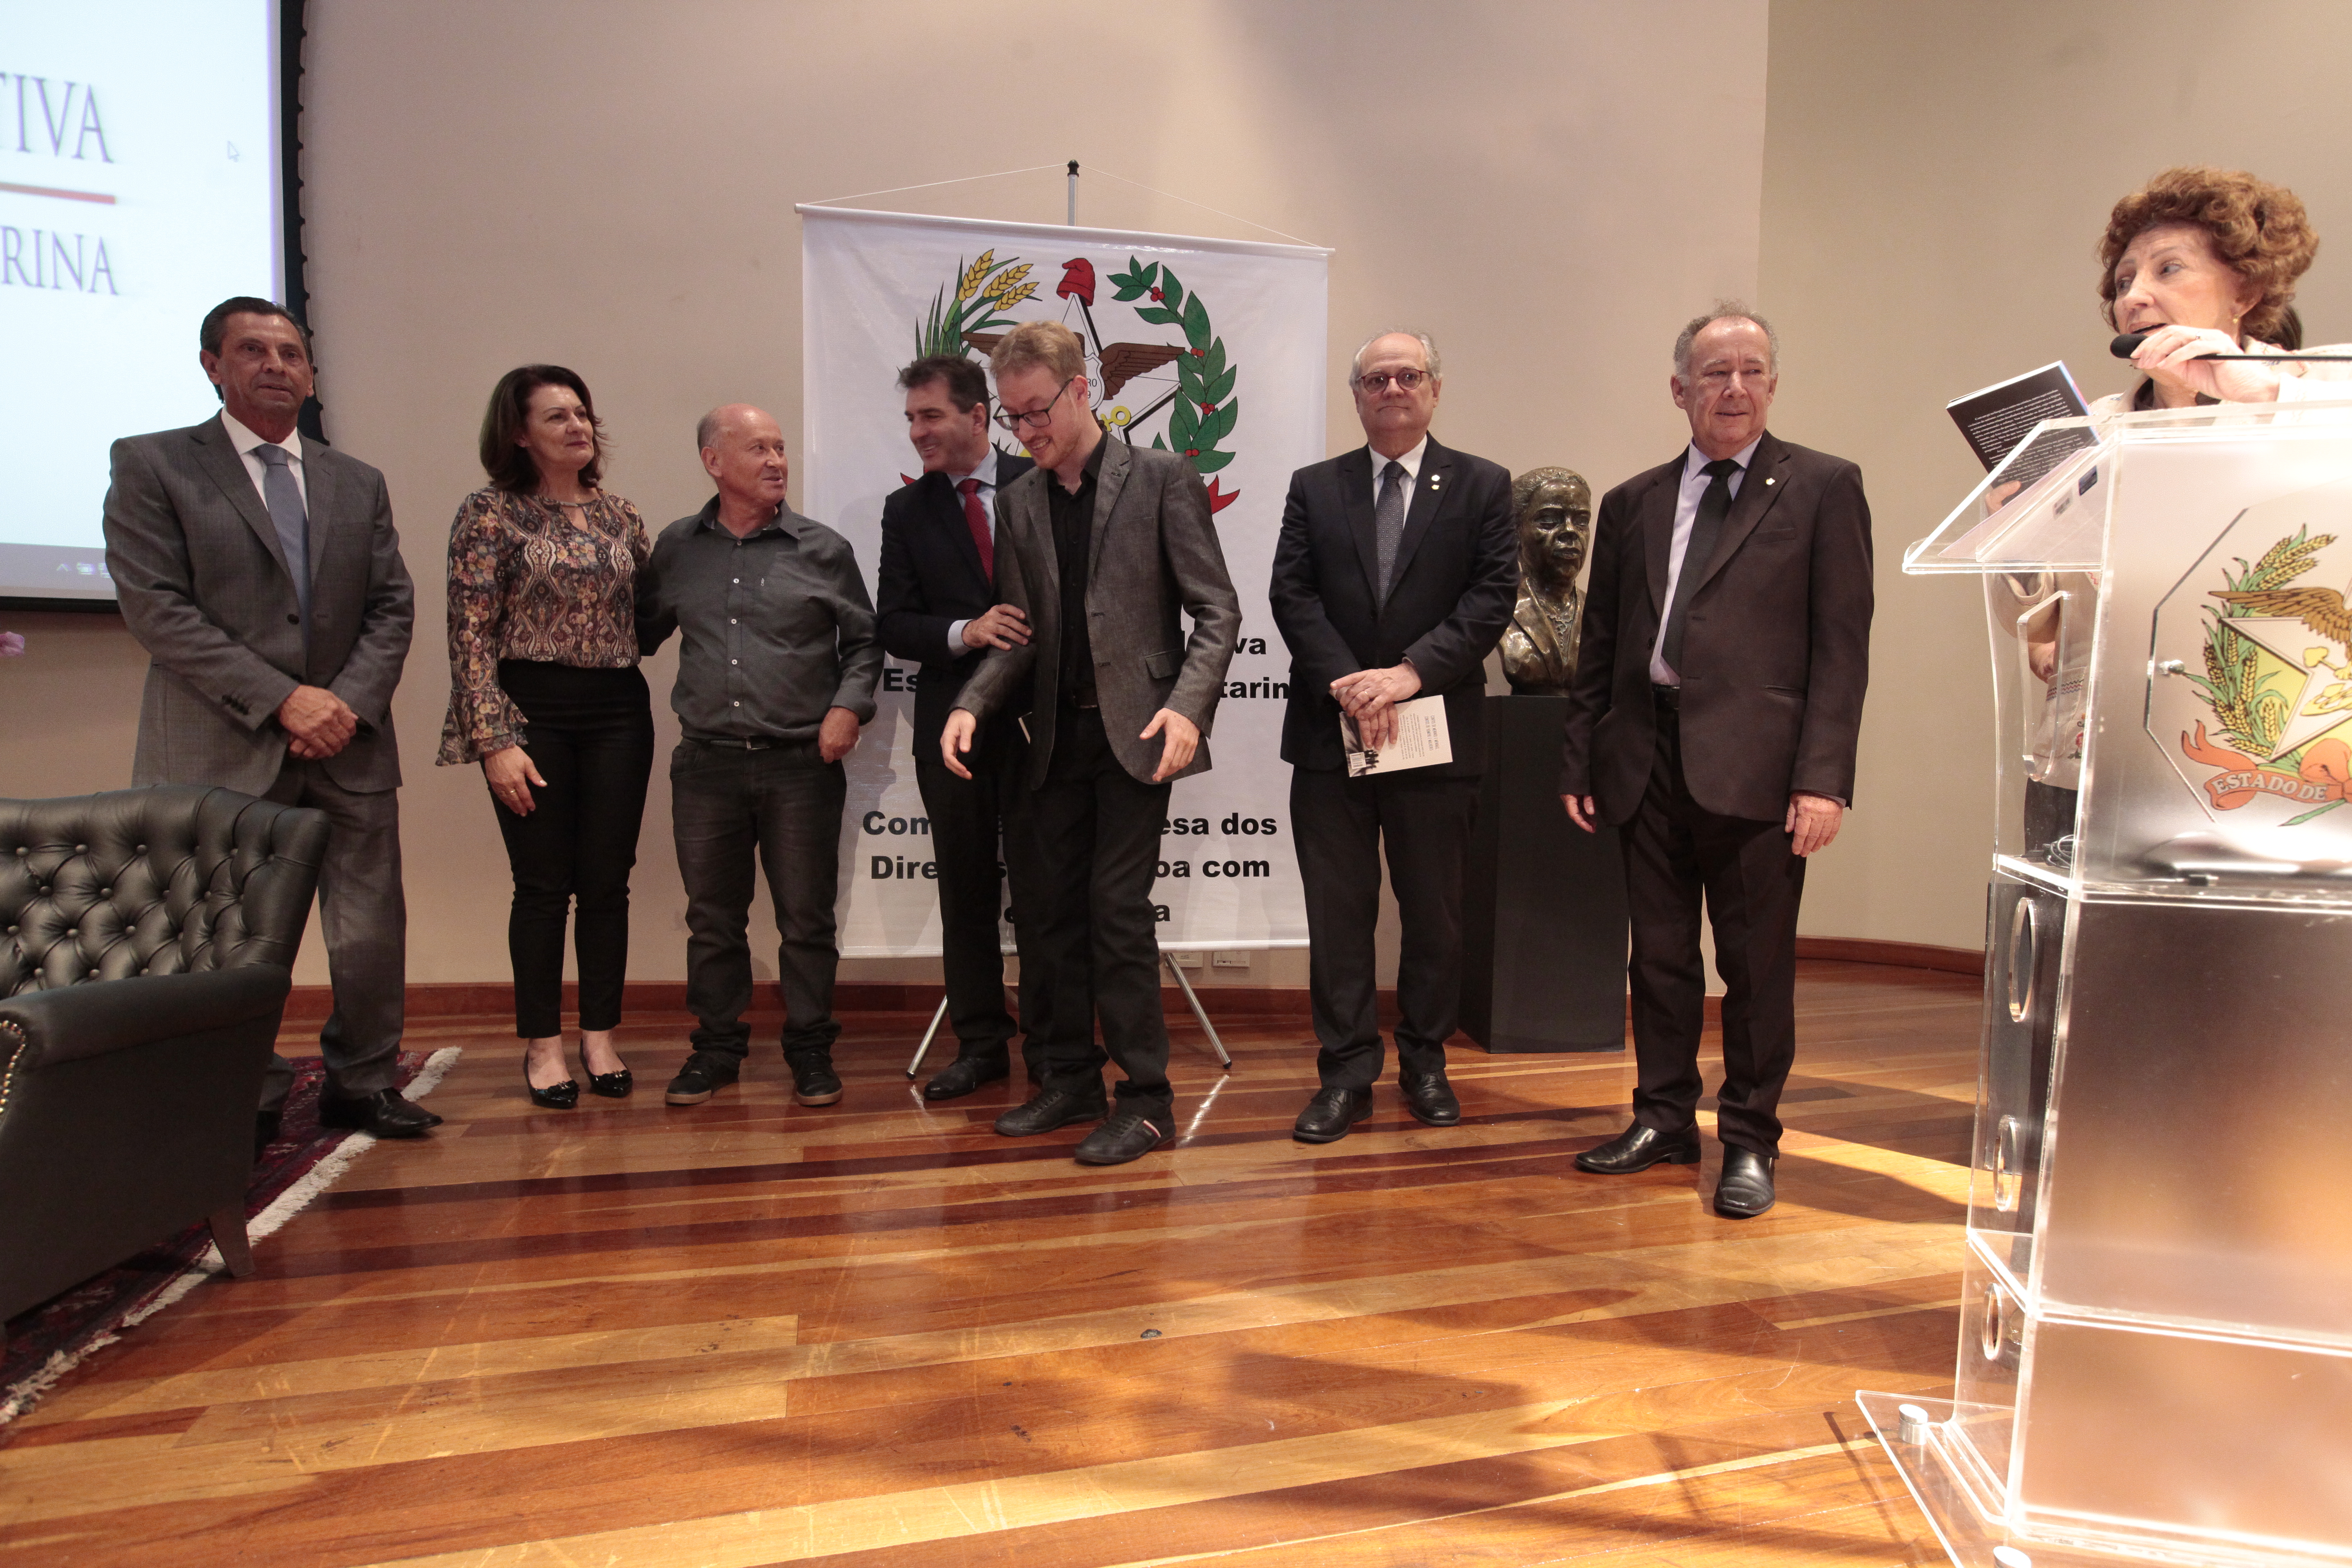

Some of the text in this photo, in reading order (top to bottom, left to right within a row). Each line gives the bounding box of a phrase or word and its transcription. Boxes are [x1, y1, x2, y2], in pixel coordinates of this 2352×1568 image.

[0, 71, 114, 163] IVA
[1, 225, 119, 296] RINA
[1086, 378, 1097, 387] RO
[1234, 638, 1266, 655] va
[883, 668, 1289, 699] Es tarin
[2211, 773, 2327, 800] ESTADO DE
[863, 811, 1277, 836] Com esa dos
[871, 856, 1270, 879] Dire oa com
[1153, 904, 1171, 922] a
